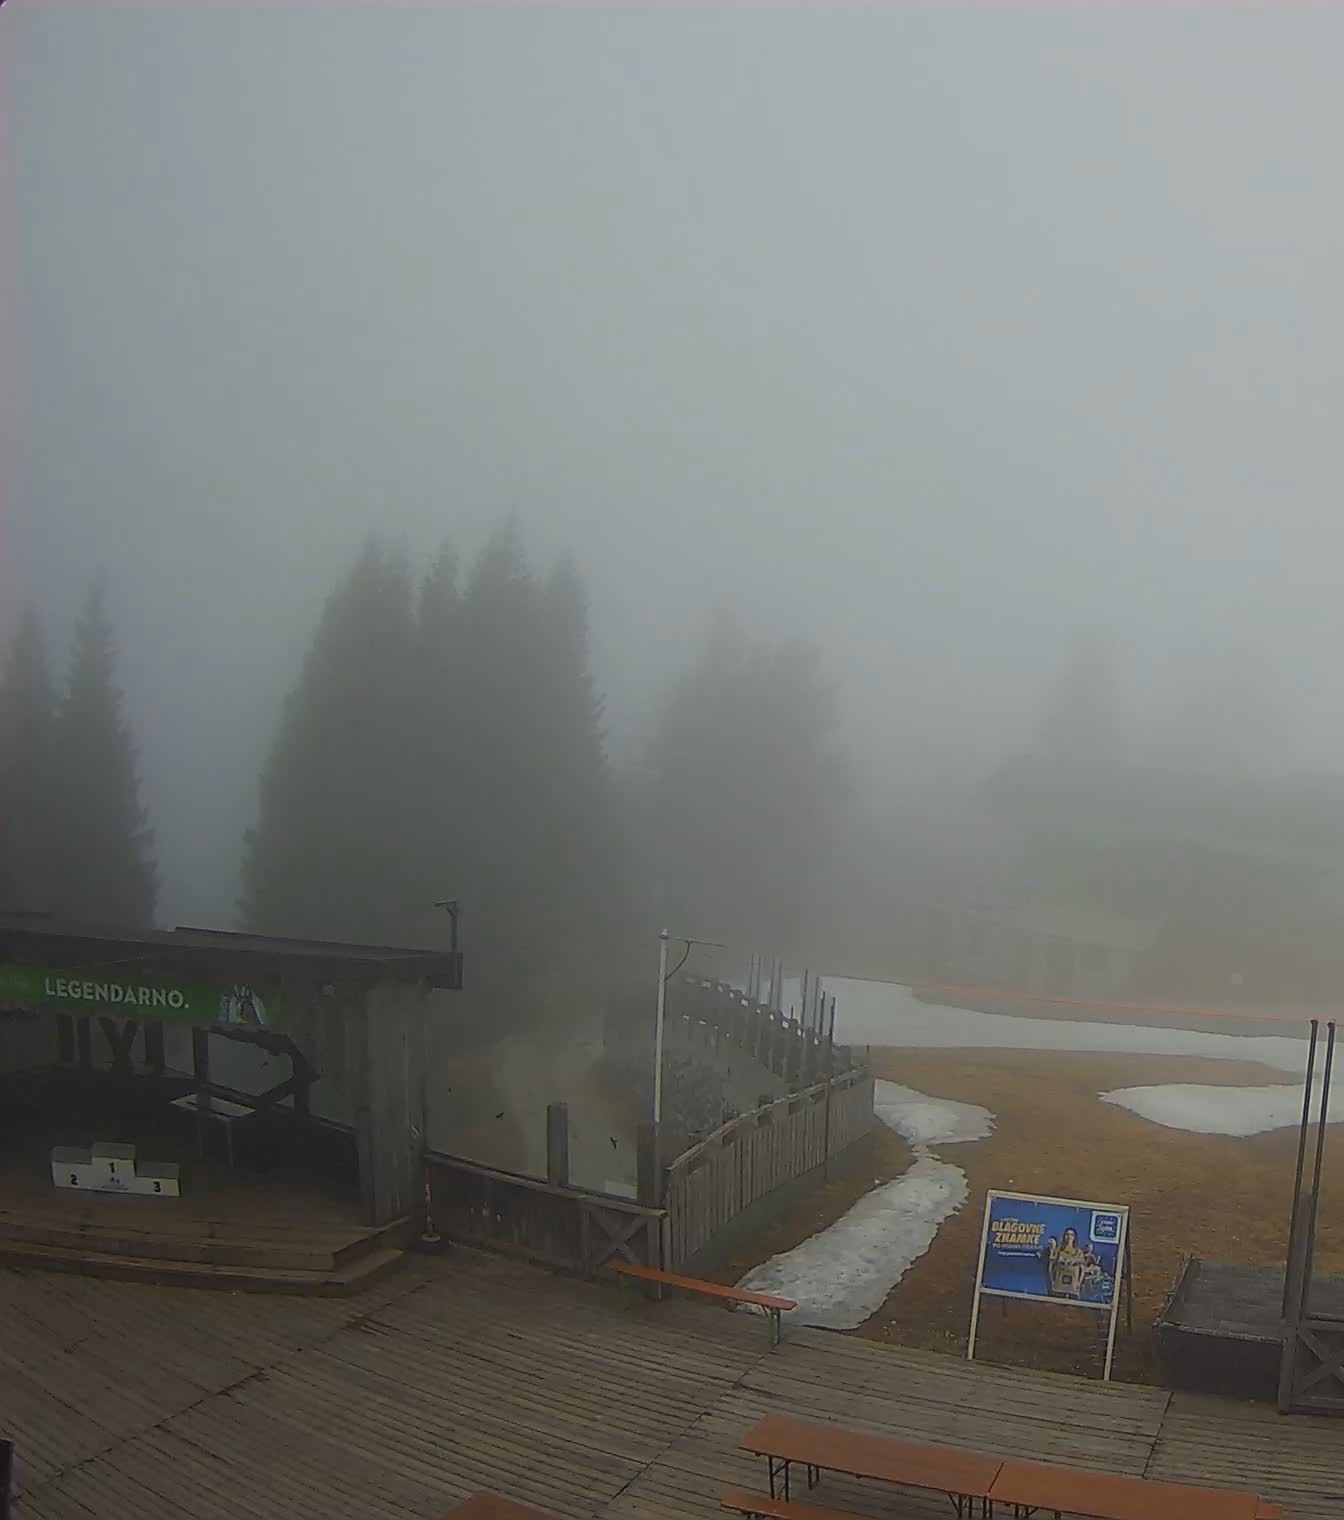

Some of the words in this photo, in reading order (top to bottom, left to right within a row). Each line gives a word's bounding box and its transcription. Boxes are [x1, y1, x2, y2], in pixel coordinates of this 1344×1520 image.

[44, 976, 190, 1009] LEGENDARNO.
[109, 1162, 116, 1173] 1
[70, 1174, 78, 1185] 2
[153, 1181, 161, 1192] 3
